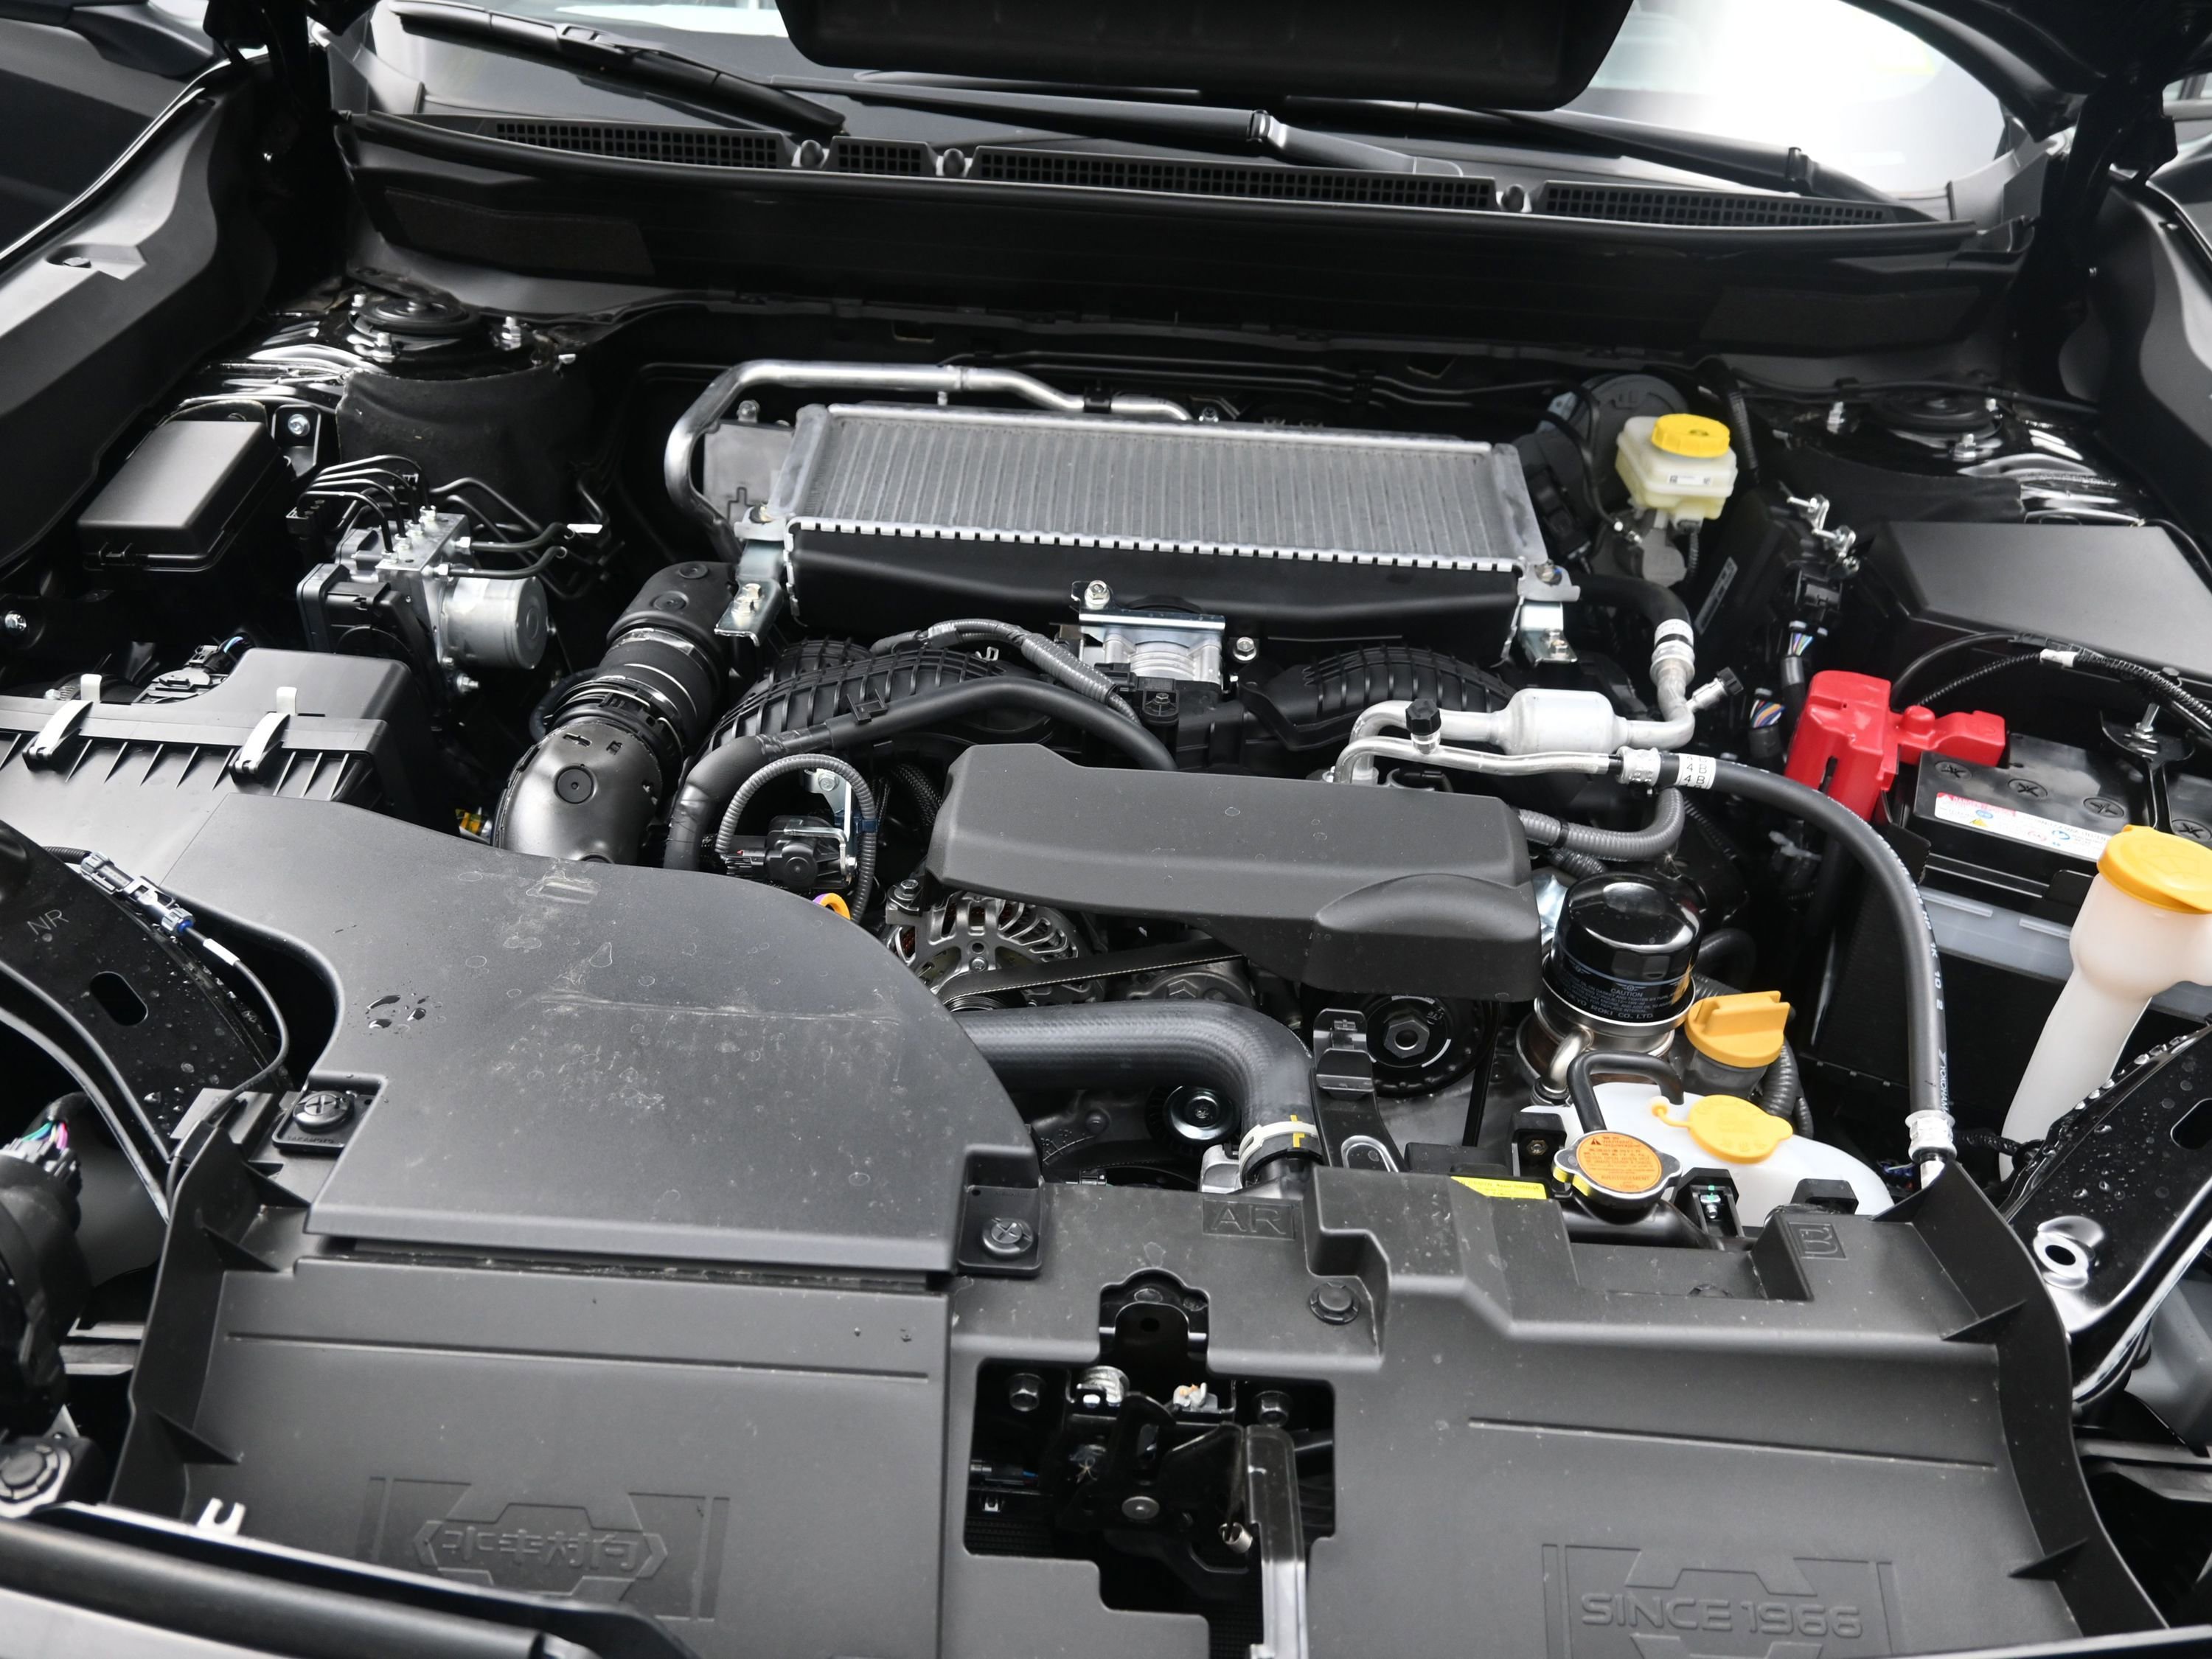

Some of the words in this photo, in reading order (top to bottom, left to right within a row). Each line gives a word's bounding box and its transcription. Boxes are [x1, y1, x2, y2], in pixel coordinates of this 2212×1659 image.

[27, 908, 69, 936] NR
[1610, 988, 1644, 998] CAUTION
[1940, 1065, 1949, 1112] YOKOHAM
[1210, 1202, 1287, 1236] AR
[1582, 1591, 1733, 1631] SINCE
[1740, 1600, 1863, 1638] 1966
